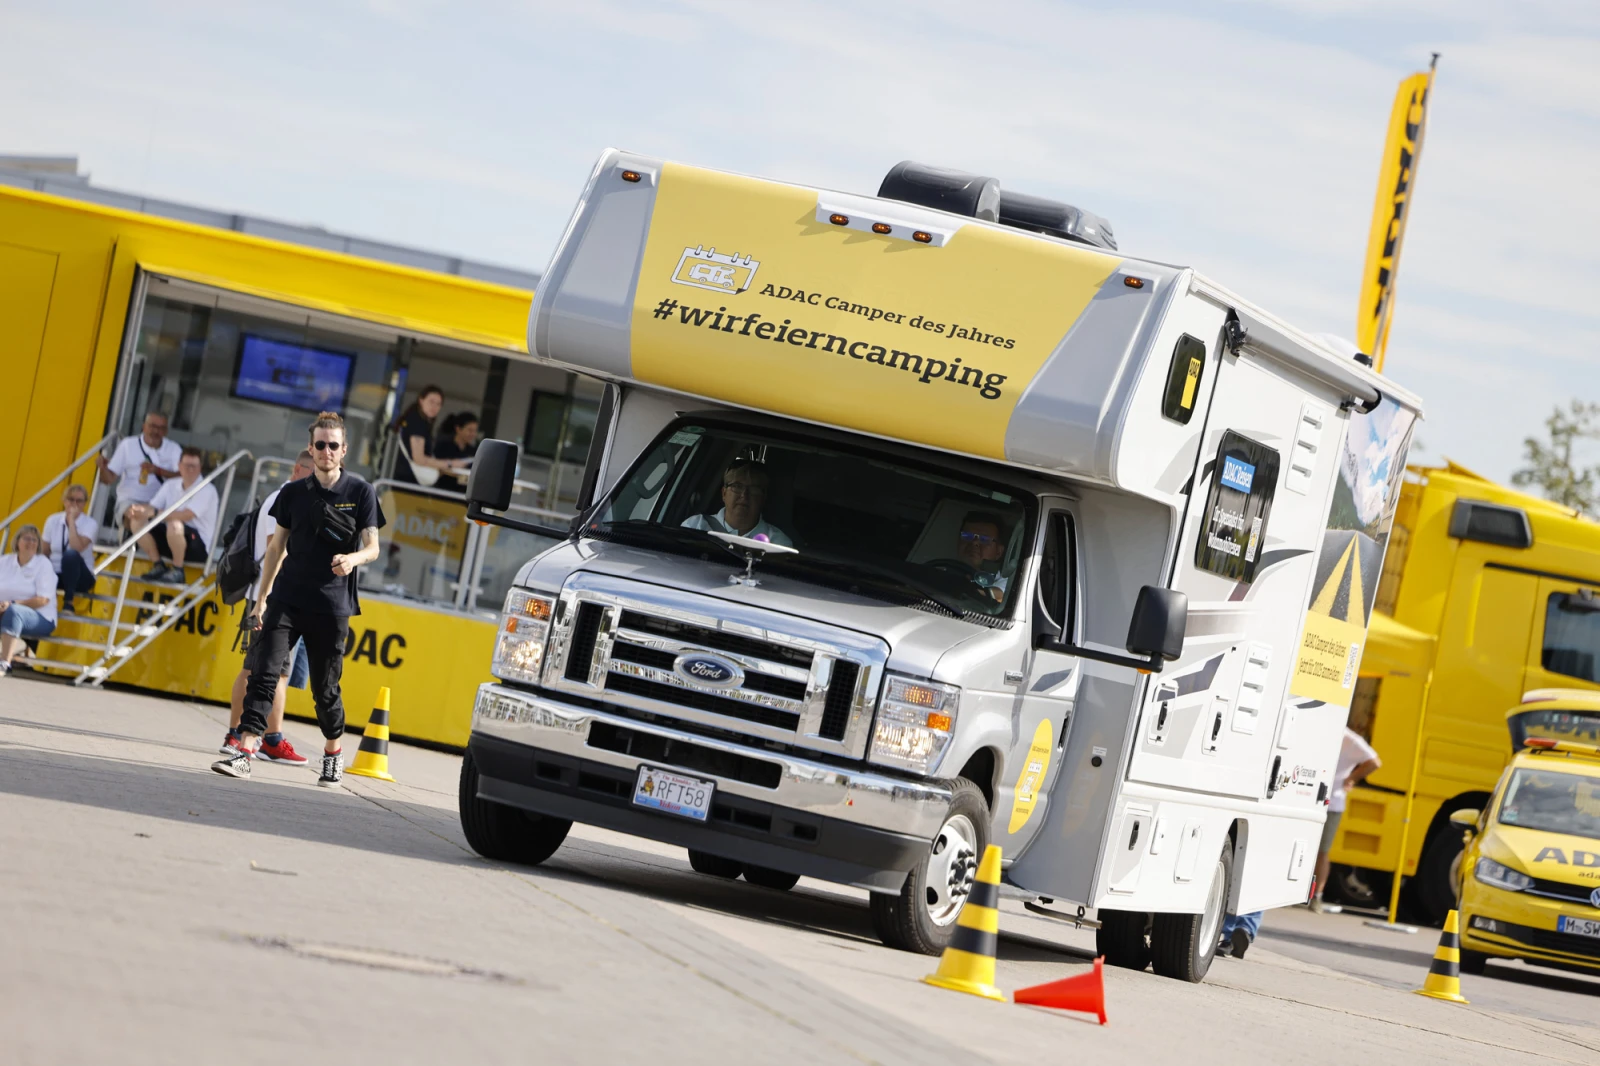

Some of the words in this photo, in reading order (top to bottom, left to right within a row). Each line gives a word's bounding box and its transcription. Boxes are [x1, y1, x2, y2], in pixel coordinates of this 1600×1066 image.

[759, 283, 822, 306] ADAC
[824, 296, 907, 324] Camper
[909, 315, 946, 334] des
[946, 323, 1016, 350] Jahres
[653, 297, 1008, 400] #wirfeierncamping
[1222, 461, 1239, 483] ADAC
[1235, 466, 1253, 489] Reisen
[393, 512, 450, 544] ADAC
[690, 661, 723, 679] Ford
[656, 780, 705, 808] RFT58
